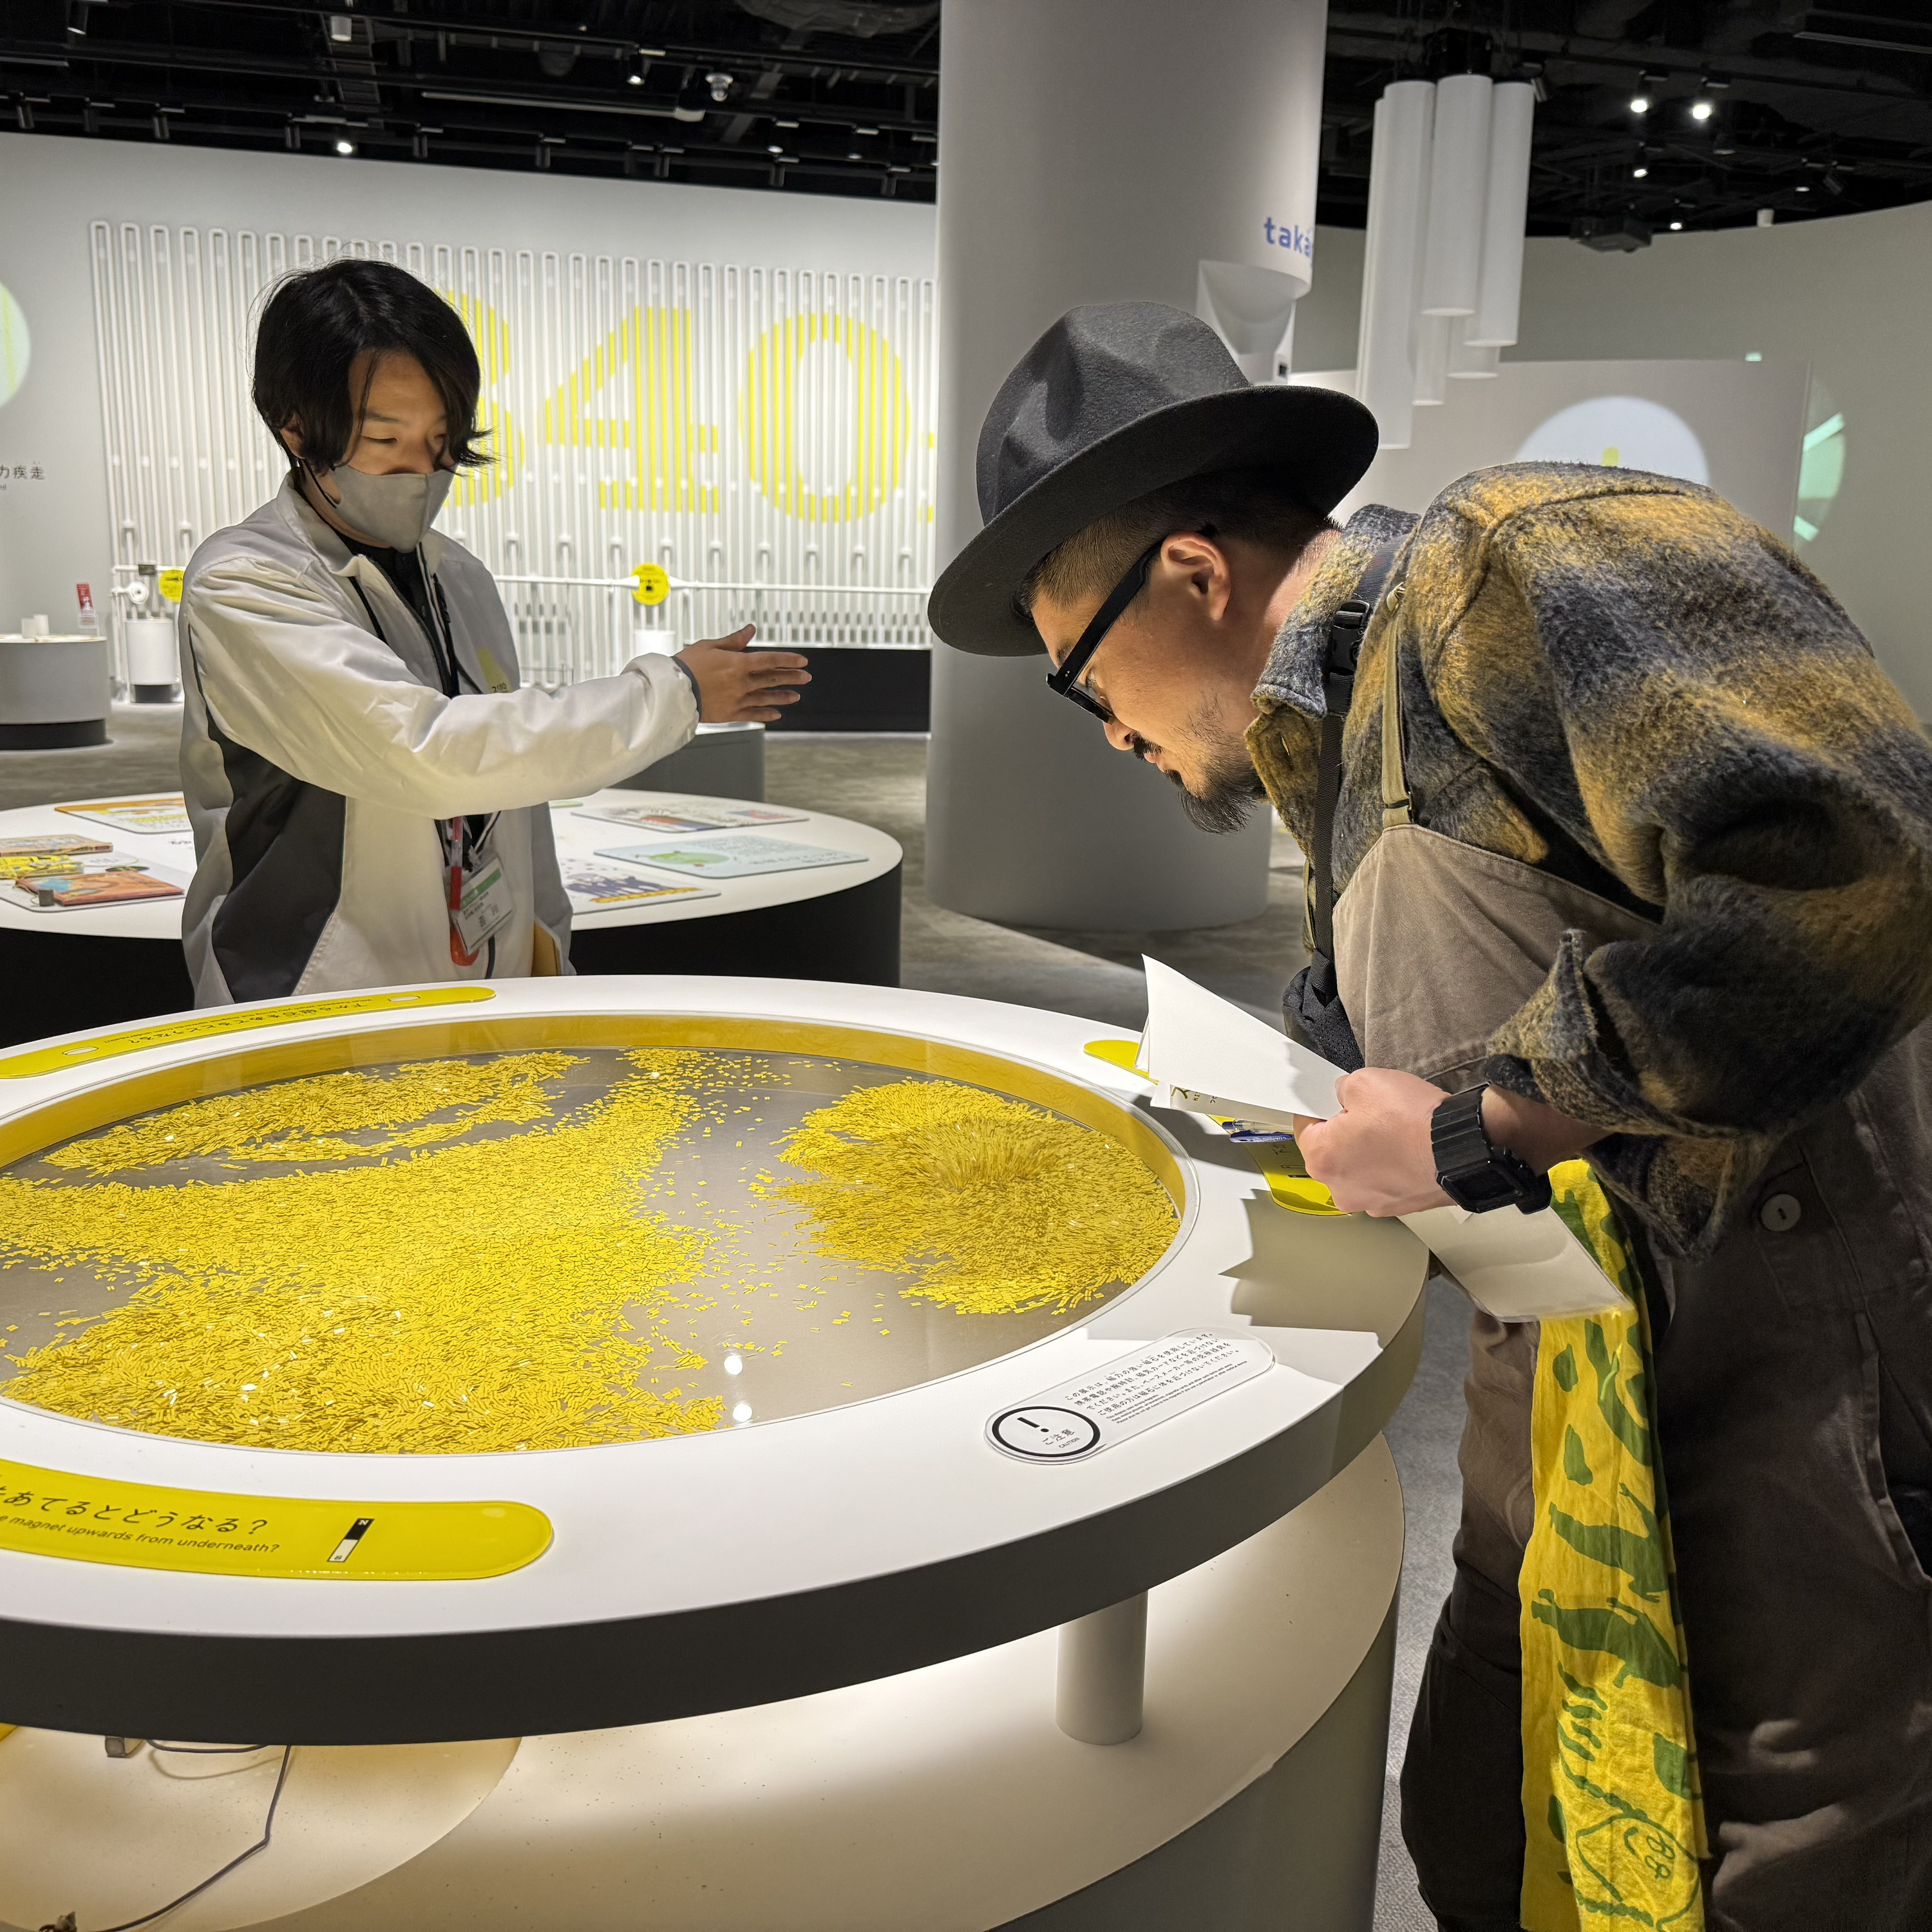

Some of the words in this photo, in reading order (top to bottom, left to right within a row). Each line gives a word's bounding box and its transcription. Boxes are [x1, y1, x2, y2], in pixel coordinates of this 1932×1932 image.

[1042, 1428, 1075, 1445] ご注意
[1058, 1437, 1080, 1448] CAUTION
[0, 1486, 268, 1535] あてるとどうなる？
[9, 1516, 66, 1532] magnet
[66, 1524, 133, 1541] upwards
[135, 1533, 174, 1545] from
[177, 1539, 280, 1553] underneath?
